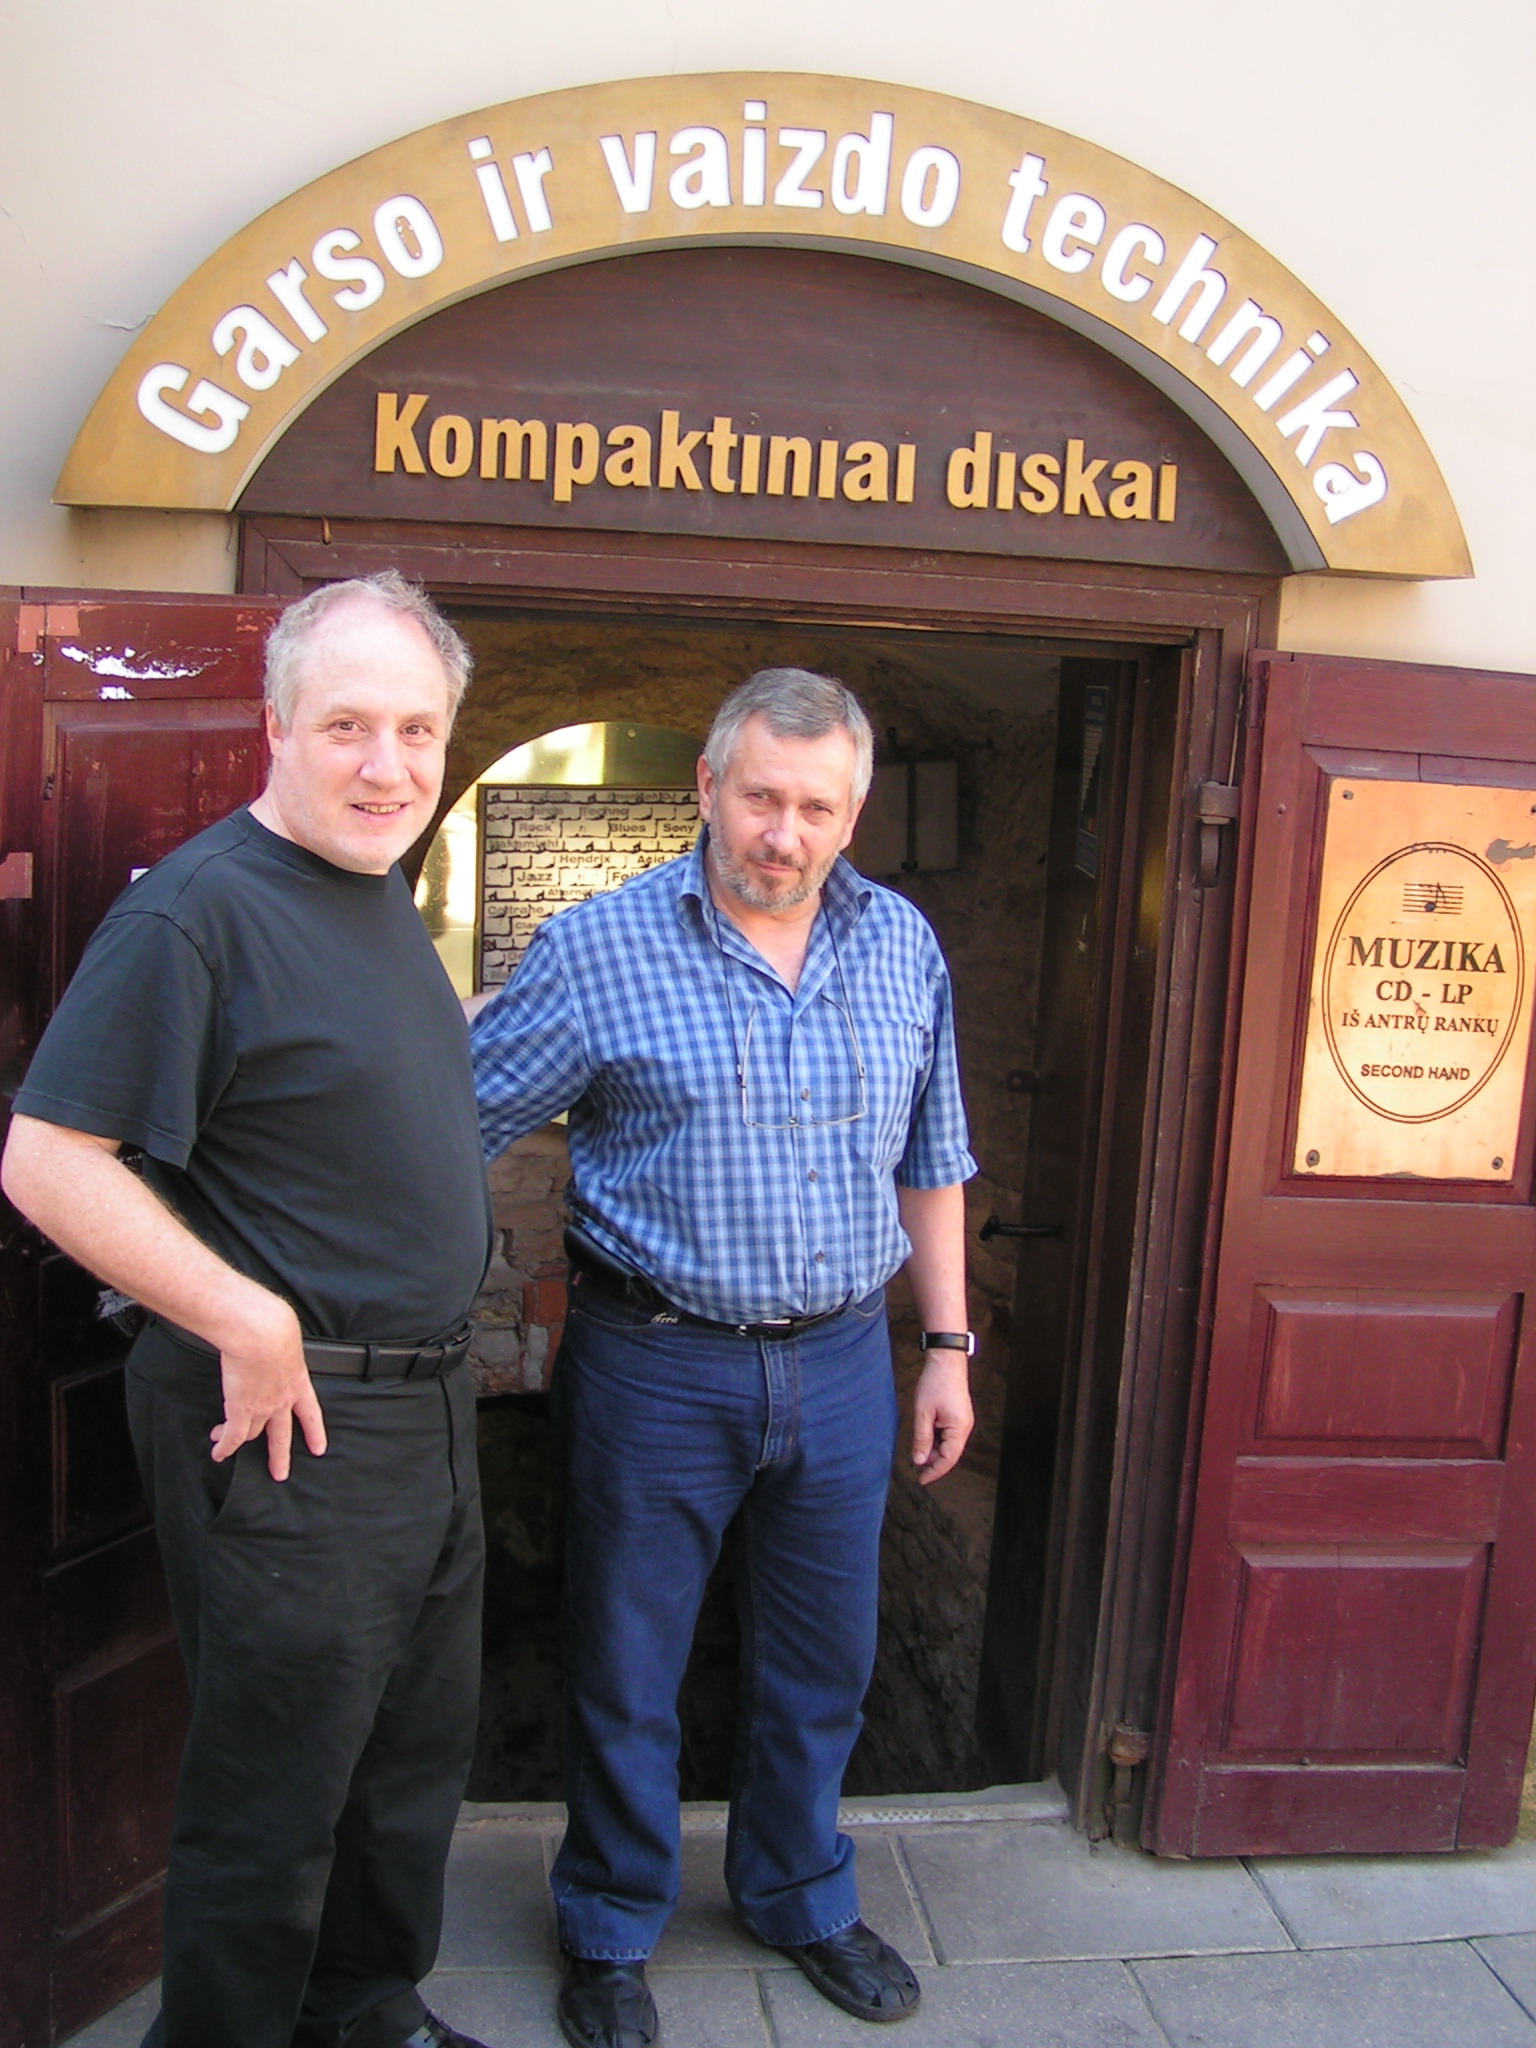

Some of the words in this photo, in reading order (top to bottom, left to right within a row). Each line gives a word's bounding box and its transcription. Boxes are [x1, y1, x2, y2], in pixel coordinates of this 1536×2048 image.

[137, 193, 445, 454] Garso
[469, 135, 553, 242] ir
[600, 99, 961, 229] vaizdo
[1000, 151, 1389, 525] technika
[520, 822, 552, 832] Rock
[609, 823, 646, 833] Blues
[663, 823, 695, 834] Sony
[560, 855, 611, 864] Hendrix
[517, 871, 553, 882] Jazz
[1347, 935, 1507, 973] MUZIKA
[1376, 980, 1413, 1001] CD
[1440, 983, 1473, 1004] LP
[1341, 1009, 1360, 1028] IŠ
[1364, 1014, 1429, 1034] ANTRŲ
[1434, 1017, 1499, 1037] RANKŲ
[1360, 1063, 1424, 1079] SECOND
[1429, 1066, 1470, 1081] HAND
